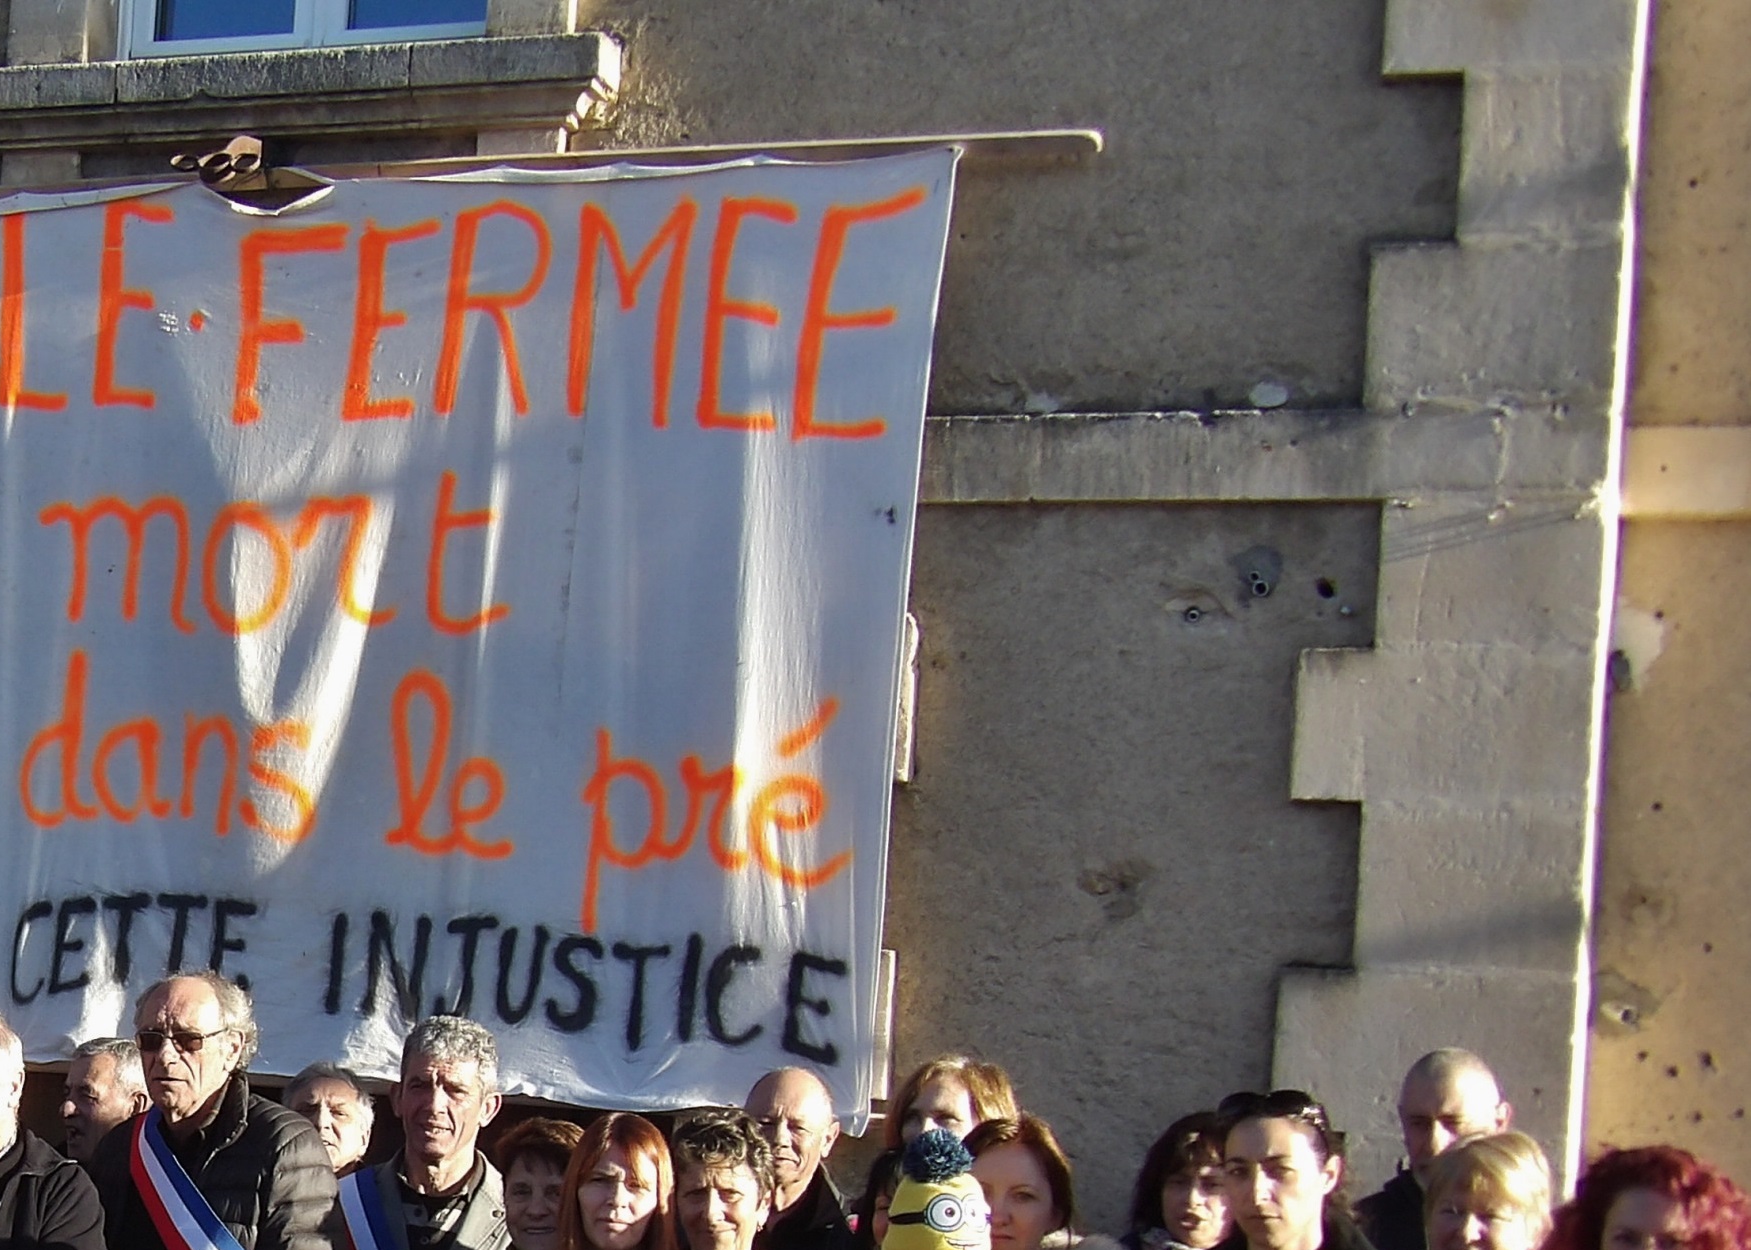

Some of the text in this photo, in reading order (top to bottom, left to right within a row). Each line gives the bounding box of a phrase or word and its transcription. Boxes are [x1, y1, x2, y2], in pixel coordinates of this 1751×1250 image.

[236, 186, 926, 440] FERMEE
[38, 468, 510, 634] mort
[20, 648, 318, 842] dans
[384, 668, 514, 858] le
[582, 698, 852, 934] pré
[10, 890, 260, 1006] CETTE
[322, 906, 848, 1066] INJUSTICE
